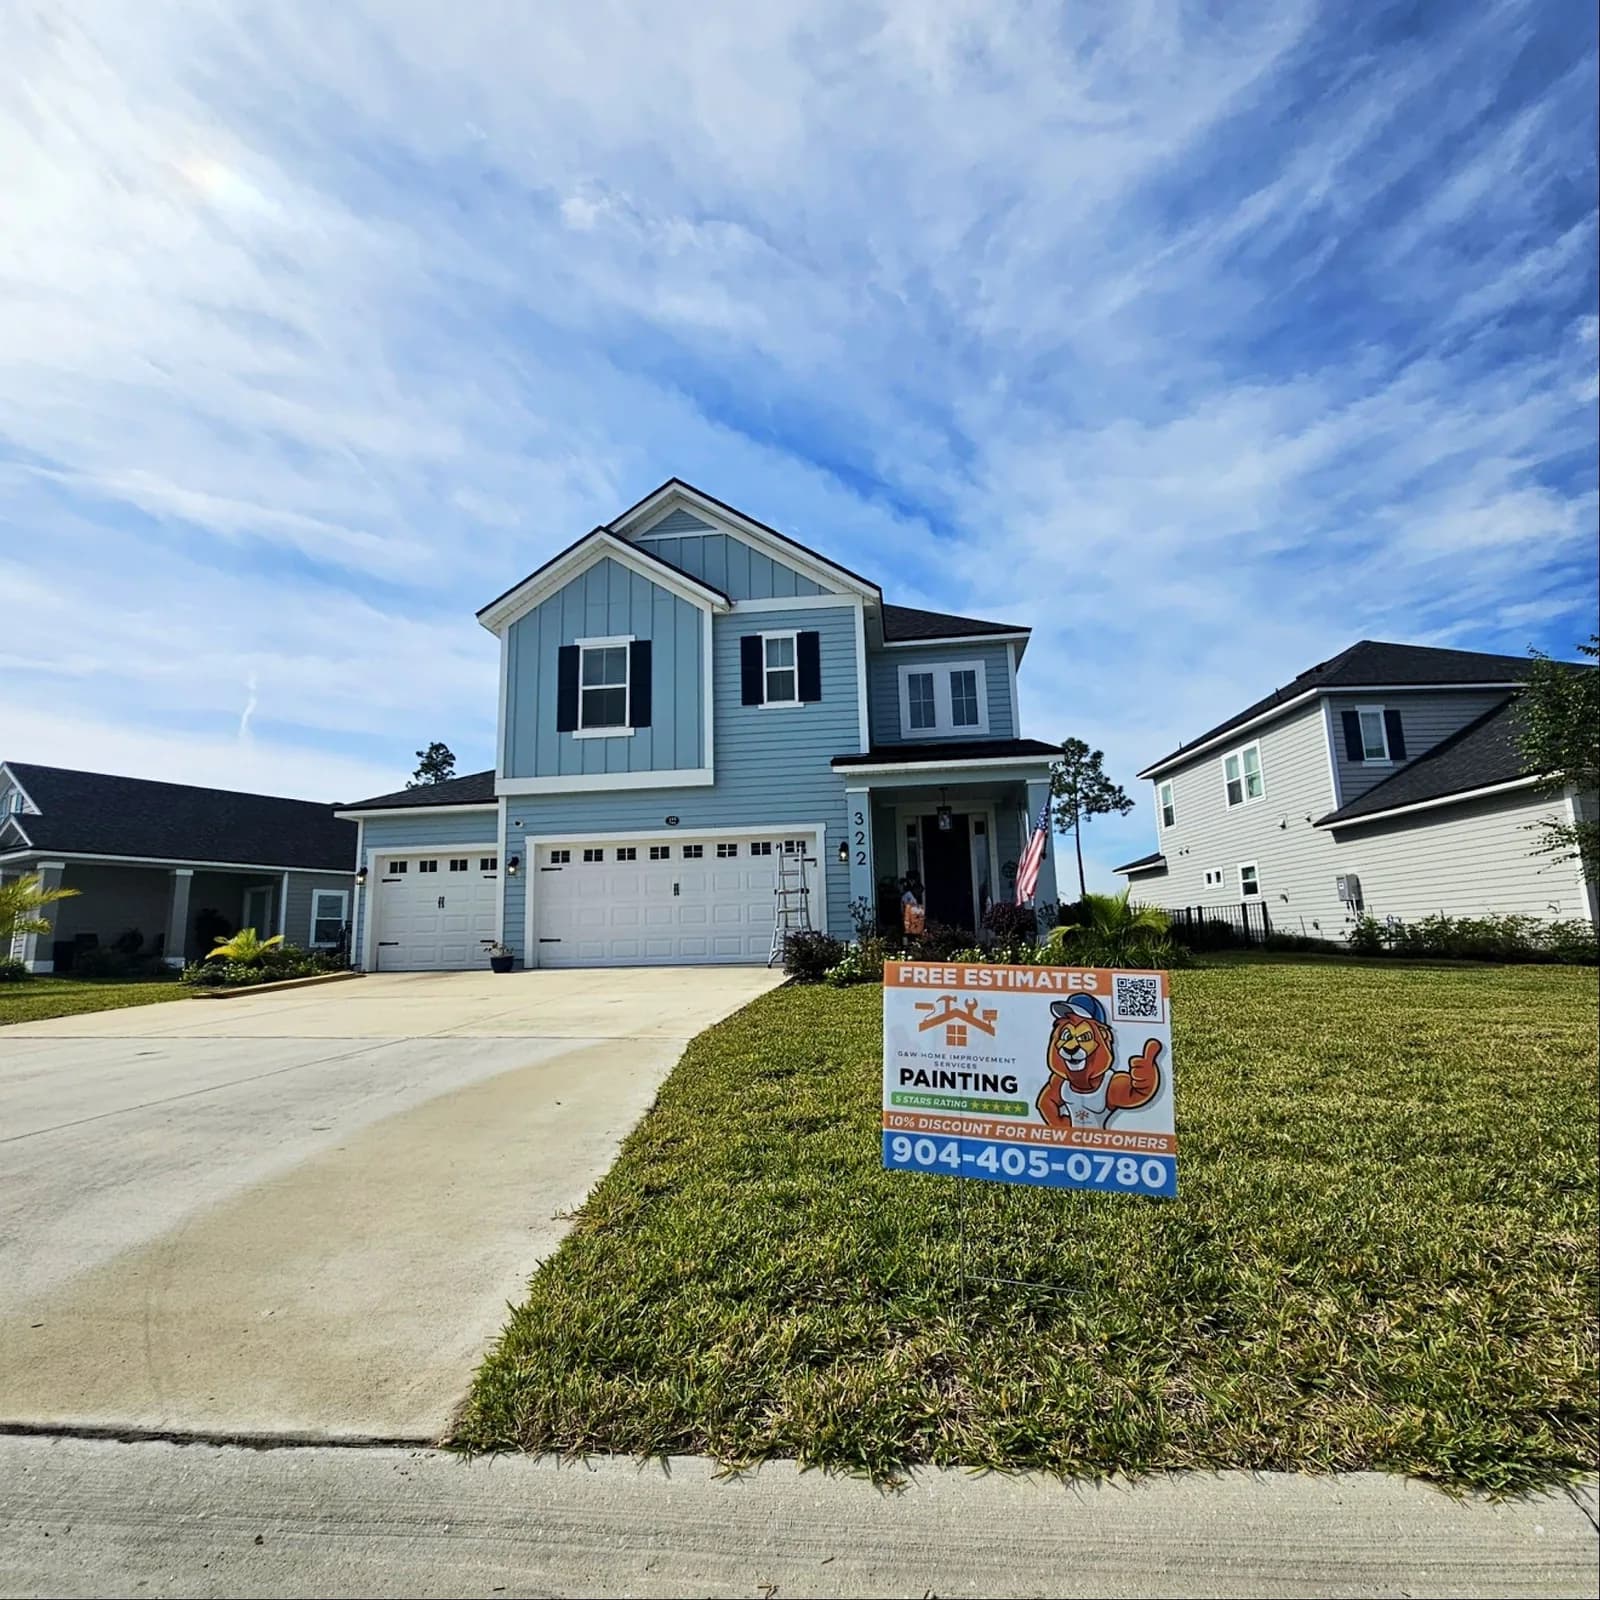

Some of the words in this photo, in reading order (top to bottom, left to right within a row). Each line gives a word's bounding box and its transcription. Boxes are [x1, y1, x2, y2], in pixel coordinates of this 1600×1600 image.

[854, 812, 866, 866] 322
[899, 966, 957, 985] FREE
[964, 968, 1098, 991] ESTIMATES
[934, 1061, 977, 1069] SERVICES
[949, 1054, 1017, 1064] IMPROVEMENT
[900, 1068, 1018, 1094] PAINTING
[903, 1096, 931, 1105] STARS
[934, 1098, 967, 1108] RATING
[889, 1116, 915, 1129] 10%
[919, 1117, 992, 1135] DISCOUNT
[996, 1125, 1026, 1140] FOR
[1030, 1128, 1067, 1142] NEW
[1071, 1131, 1169, 1150] CUSTOMERS
[891, 1136, 1168, 1188] 904-405-0780
